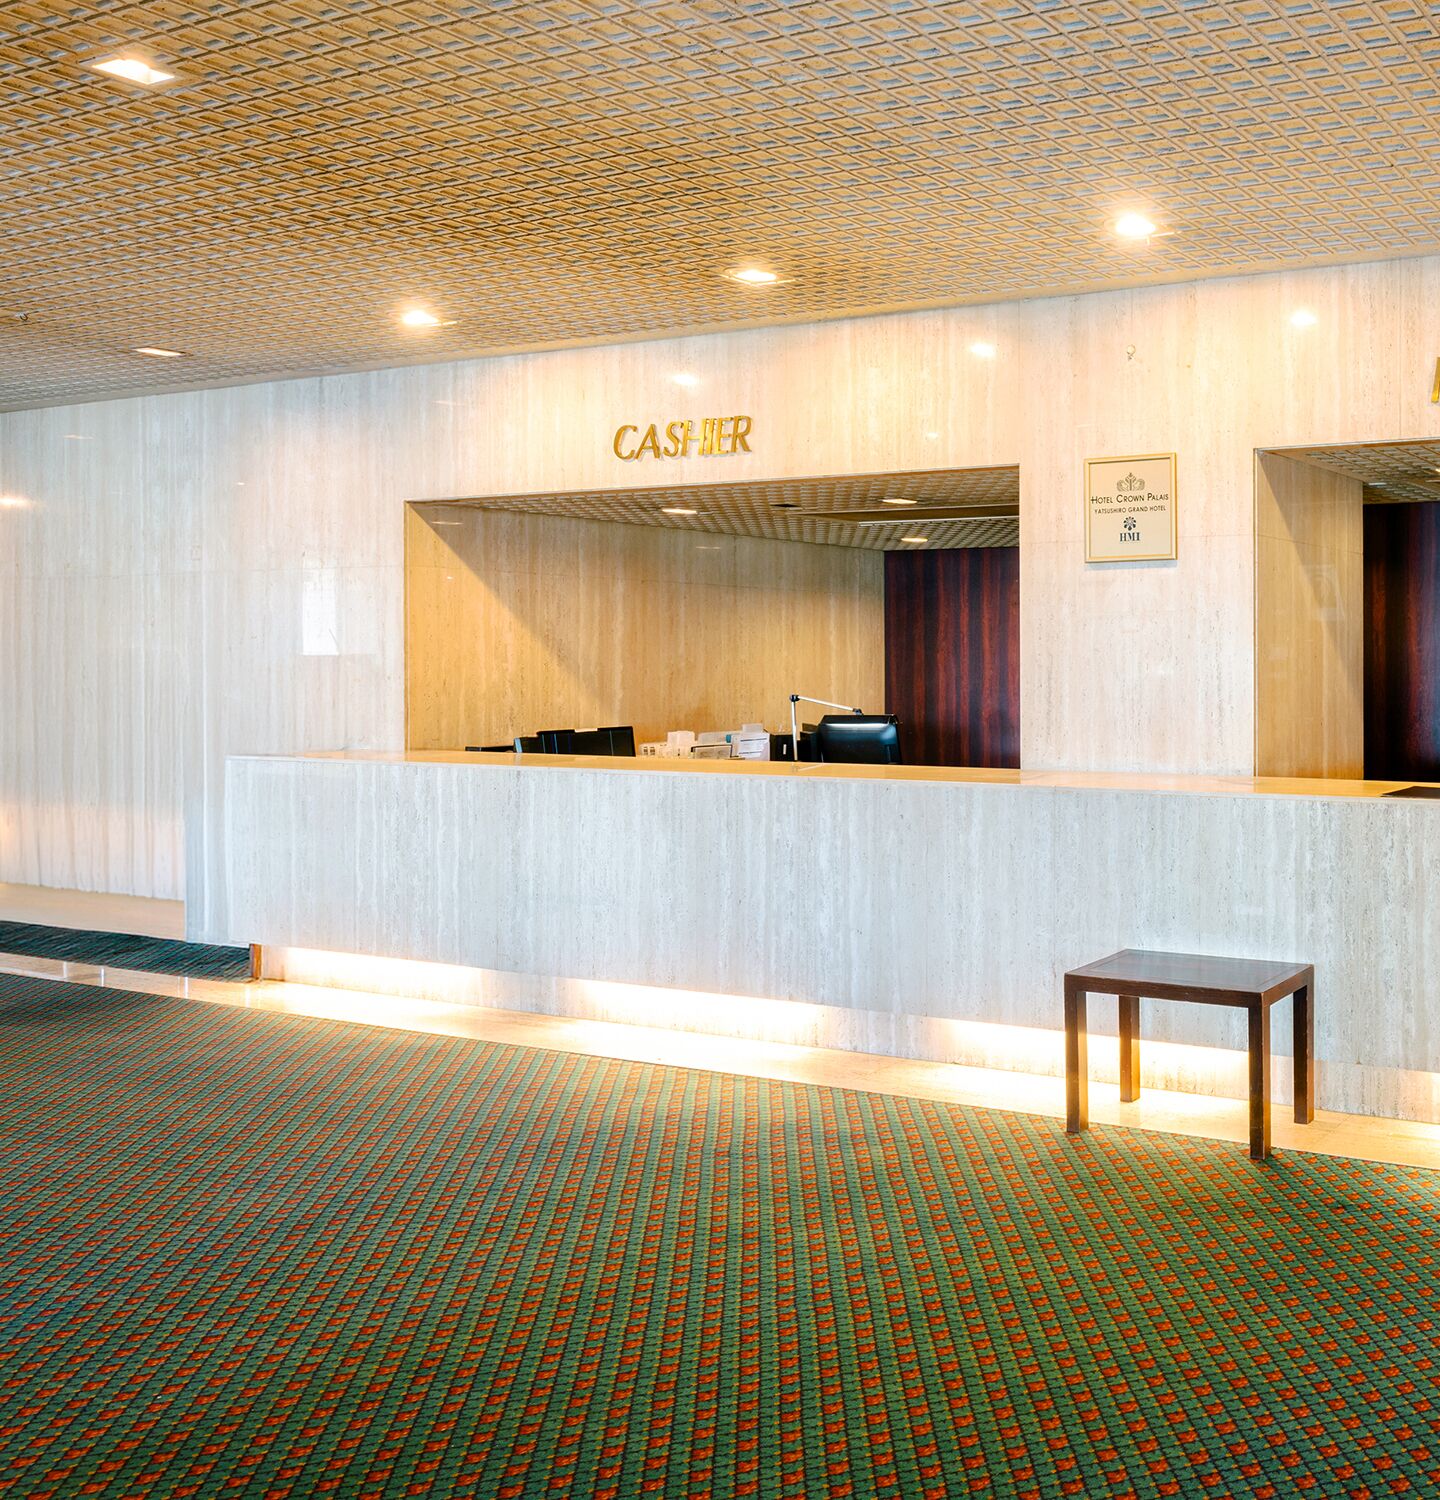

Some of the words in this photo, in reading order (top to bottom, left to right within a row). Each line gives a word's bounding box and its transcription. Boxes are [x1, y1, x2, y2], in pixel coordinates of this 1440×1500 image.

[613, 415, 752, 460] CASHIER
[1091, 496, 1113, 504] HOTEL
[1116, 494, 1145, 503] CROWN
[1147, 493, 1169, 501] PALAIS
[1120, 532, 1140, 542] HMI
